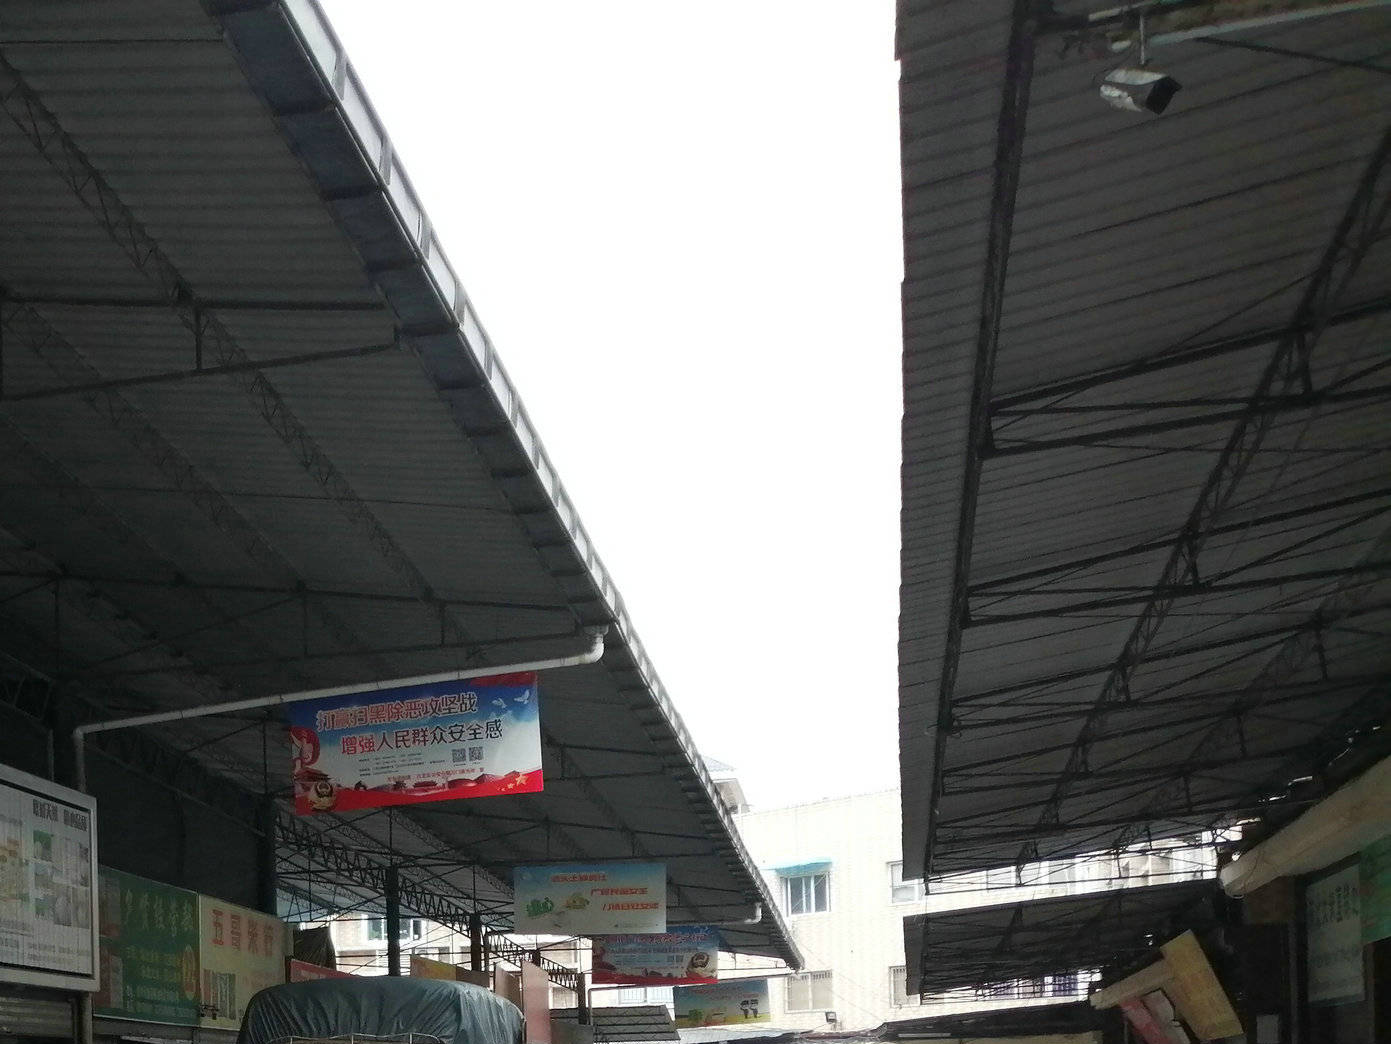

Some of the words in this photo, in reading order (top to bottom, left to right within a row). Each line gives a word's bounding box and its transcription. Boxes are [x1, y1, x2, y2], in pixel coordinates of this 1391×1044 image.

[342, 719, 503, 755] 增强人民群众安全感
